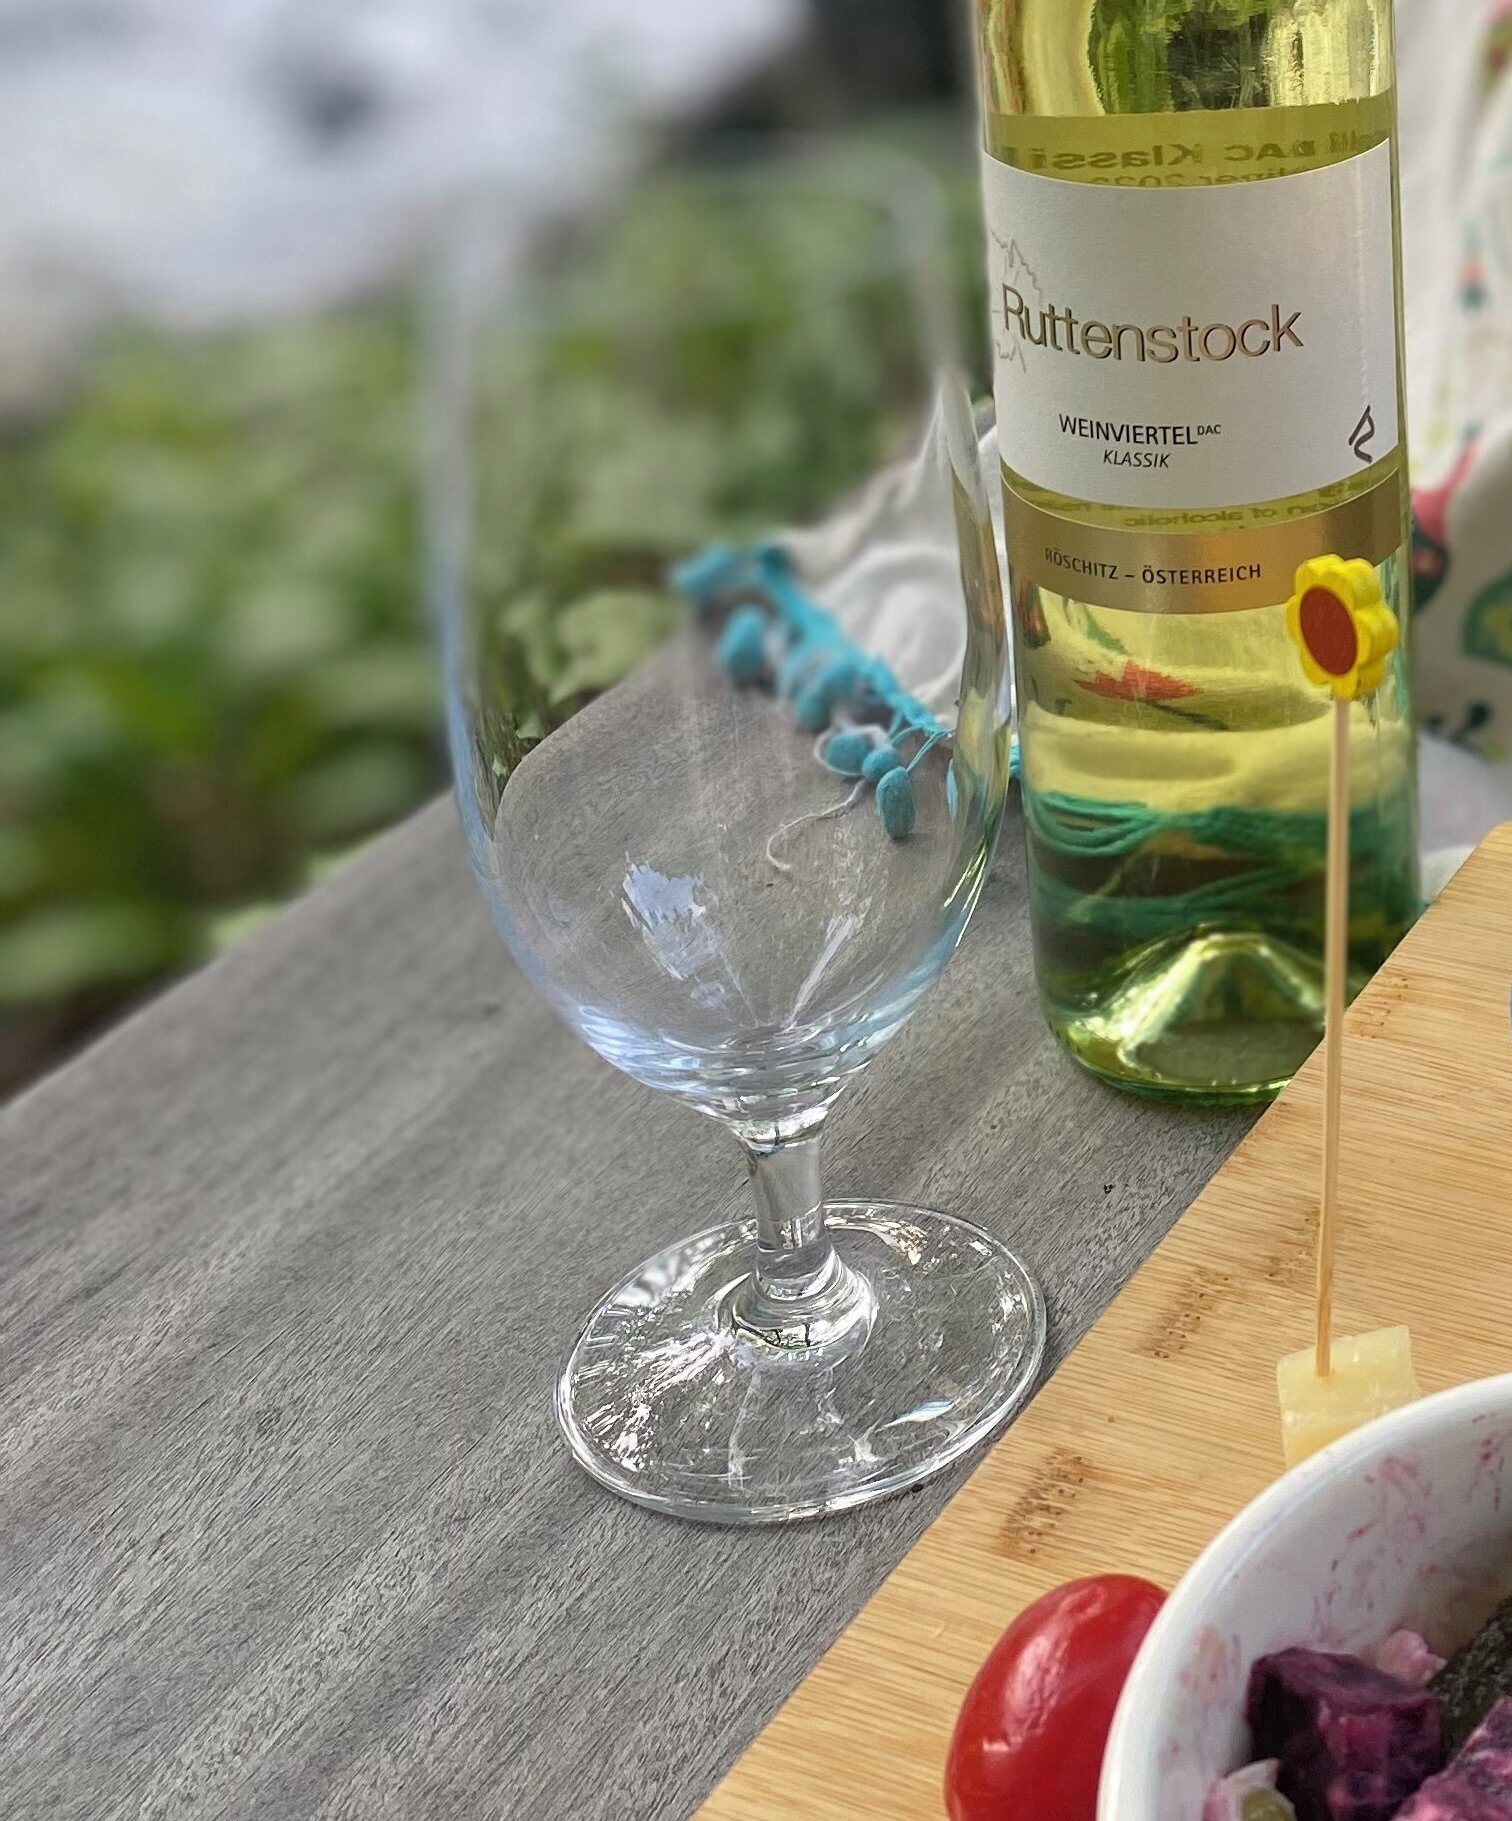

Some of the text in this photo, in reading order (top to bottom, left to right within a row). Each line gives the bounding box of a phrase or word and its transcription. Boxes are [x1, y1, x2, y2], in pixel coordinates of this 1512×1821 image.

[1001, 282, 1305, 364] Ruttenstock
[1058, 412, 1223, 446] WEINVIERTEL DAC
[1102, 448, 1172, 469] KLASSIK
[1044, 546, 1119, 580] RÖSCHITZ
[1141, 563, 1262, 585] ÖSTERREICH
